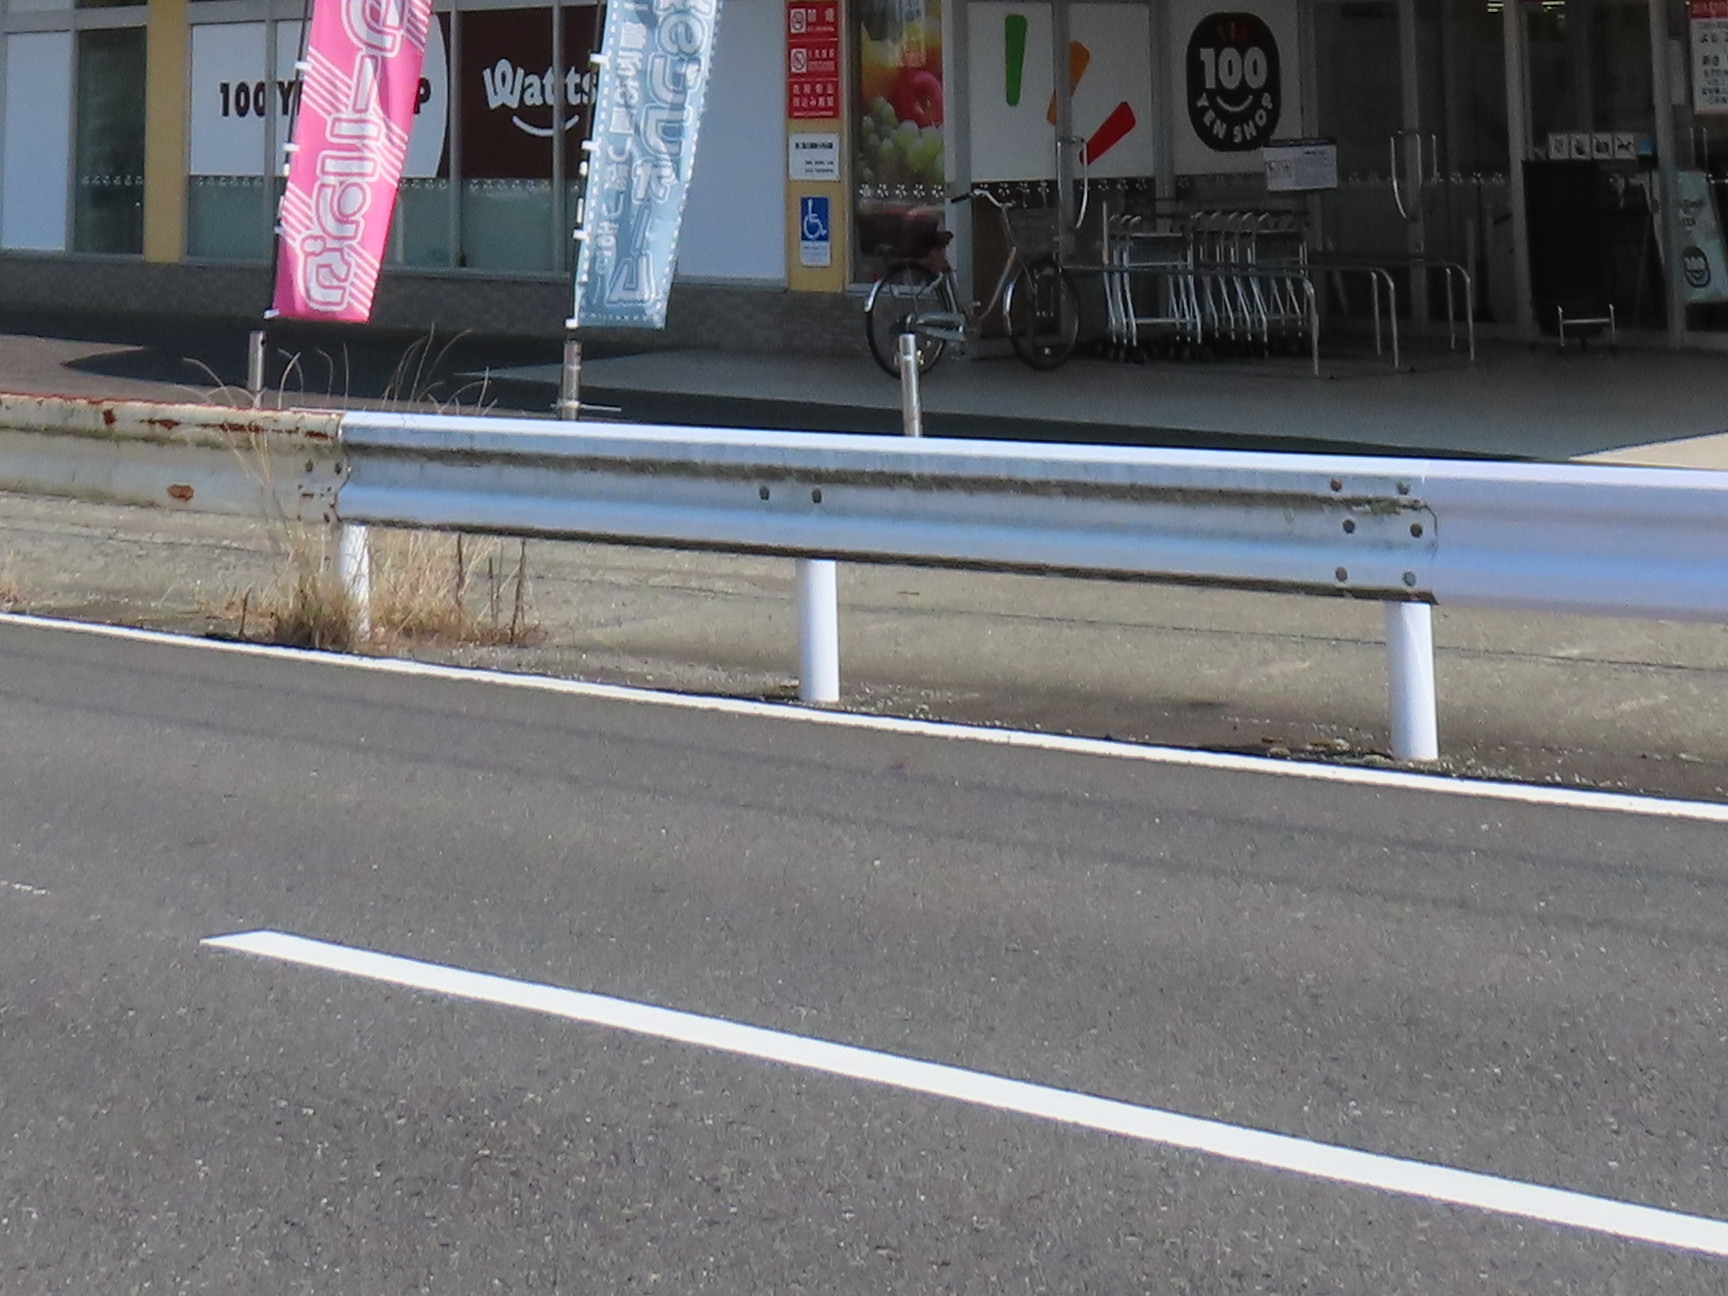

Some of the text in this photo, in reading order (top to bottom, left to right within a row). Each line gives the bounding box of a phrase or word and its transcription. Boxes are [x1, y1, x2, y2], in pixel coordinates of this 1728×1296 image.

[1200, 46, 1268, 89] 100
[219, 81, 266, 118] 100
[1195, 91, 1273, 144] YEN SHOP
